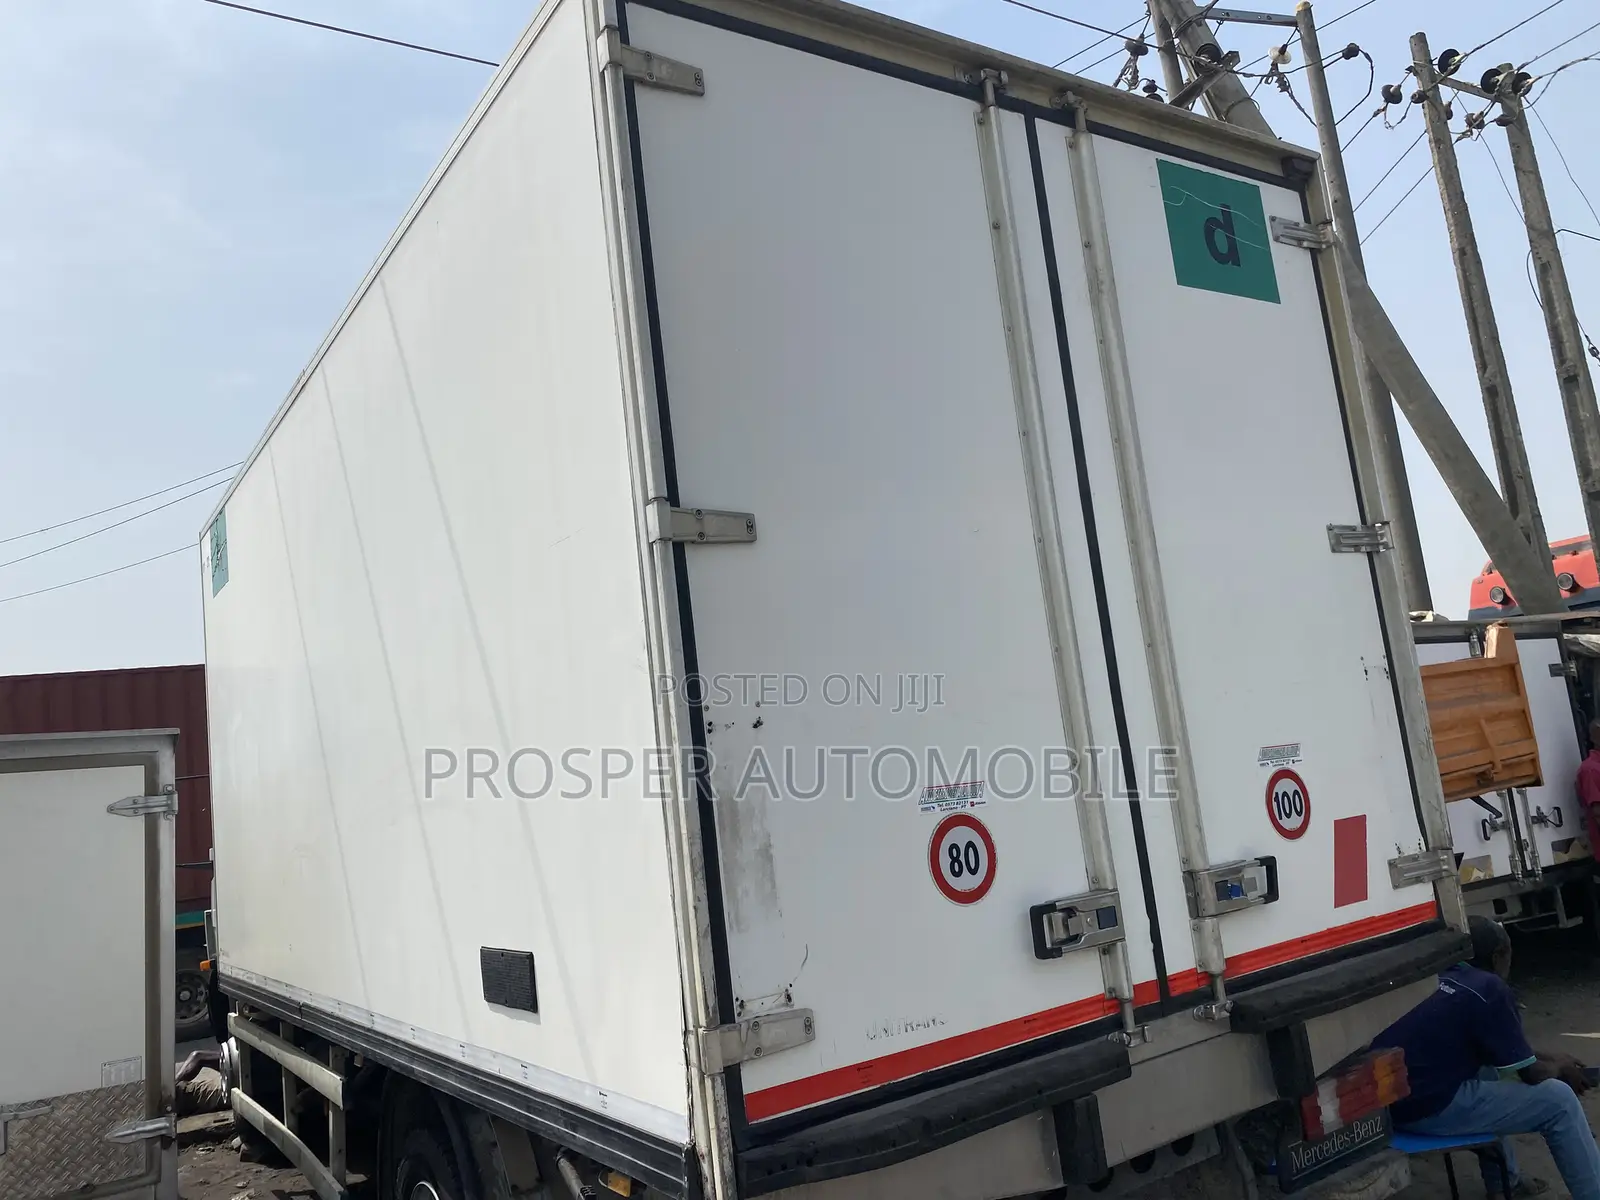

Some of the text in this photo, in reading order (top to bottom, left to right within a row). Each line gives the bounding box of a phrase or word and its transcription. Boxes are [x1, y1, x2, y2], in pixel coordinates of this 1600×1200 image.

[1274, 789, 1303, 820] 100
[948, 840, 980, 878] 80
[1291, 1116, 1383, 1173] Mercedes-Benz
